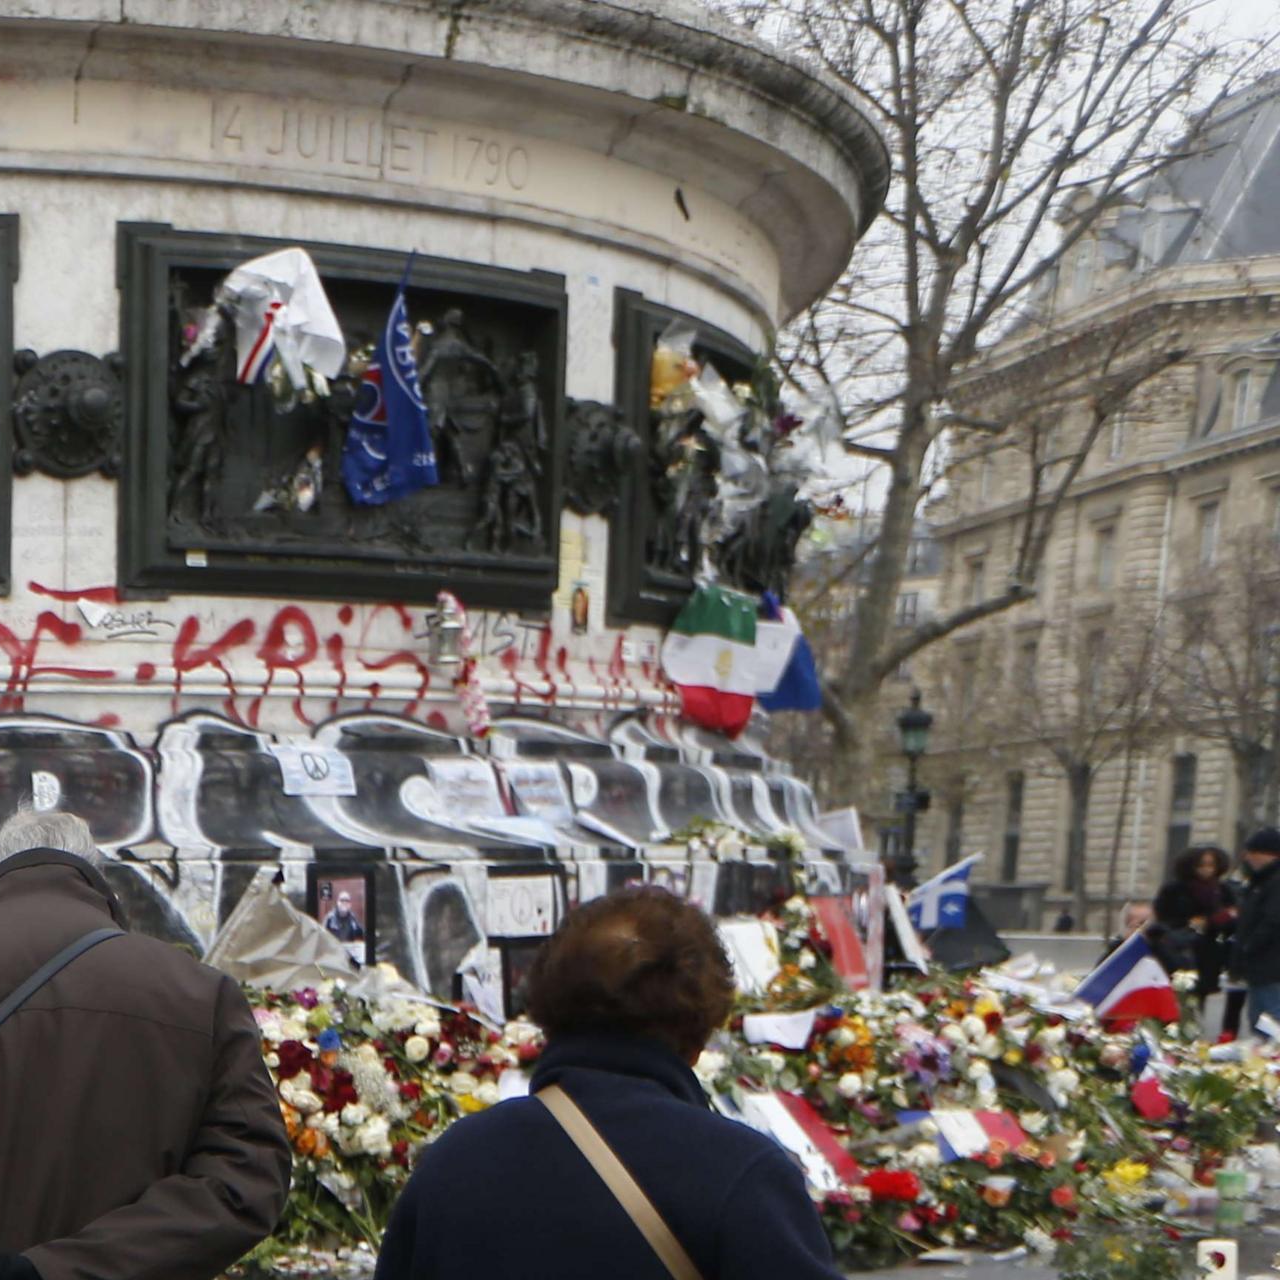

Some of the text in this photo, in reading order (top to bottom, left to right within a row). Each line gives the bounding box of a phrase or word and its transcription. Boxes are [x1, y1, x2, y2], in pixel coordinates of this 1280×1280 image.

[209, 100, 531, 190] 14 JUILLET 1790
